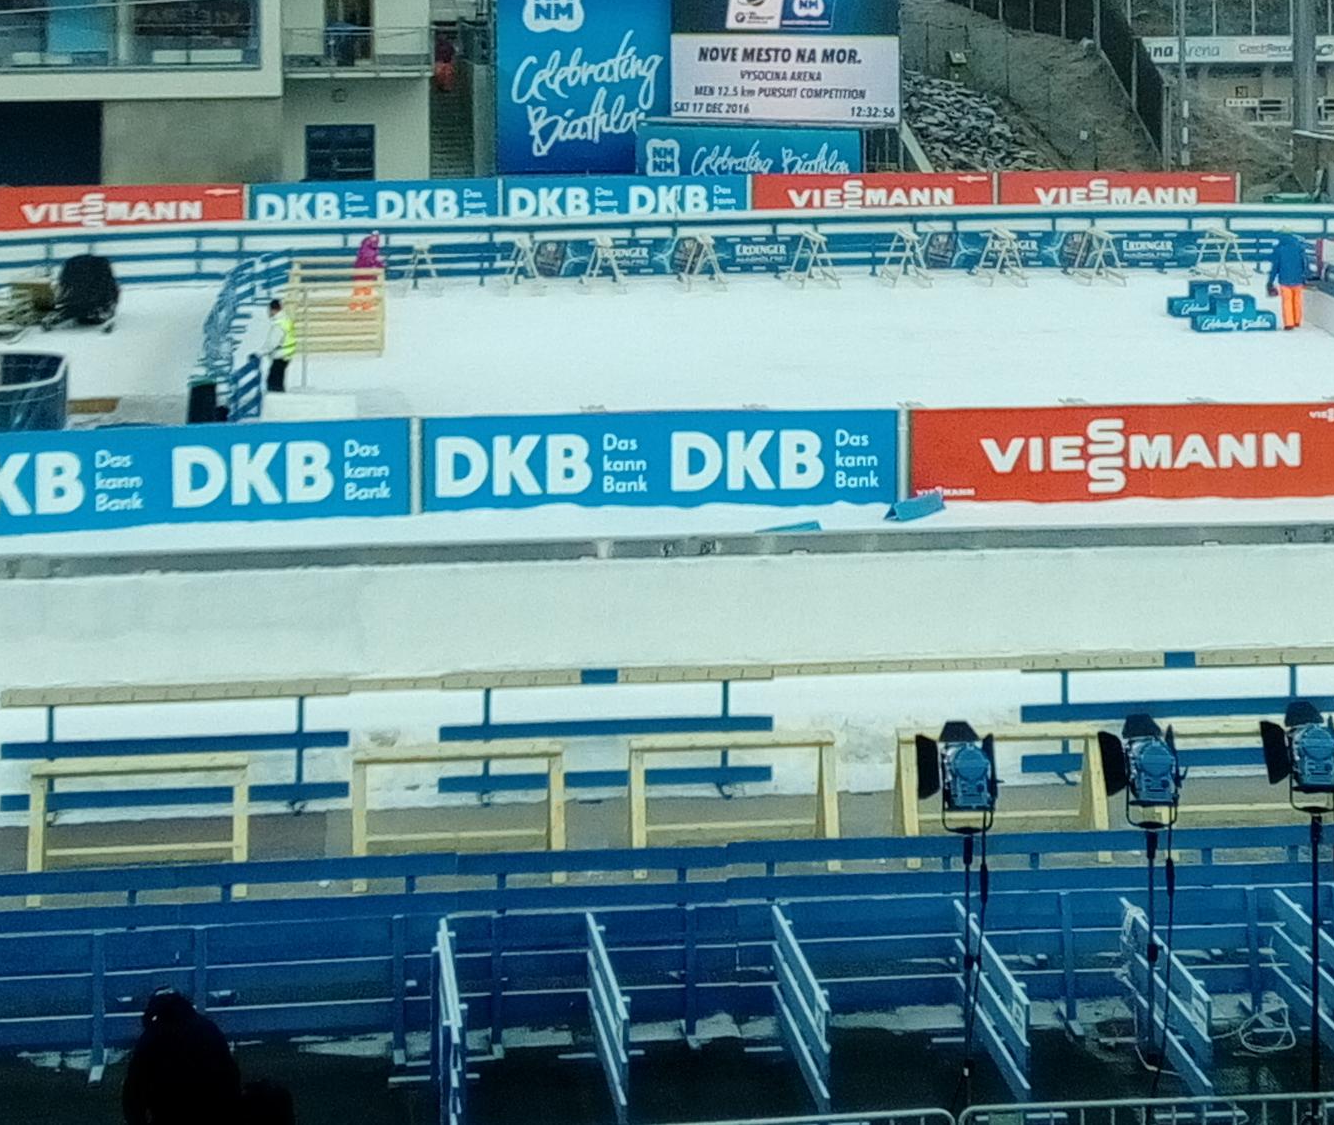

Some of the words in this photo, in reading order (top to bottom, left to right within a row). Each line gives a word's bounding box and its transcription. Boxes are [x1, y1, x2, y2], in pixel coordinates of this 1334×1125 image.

[534, 2, 574, 20] NM
[698, 46, 738, 62] NOVE
[741, 47, 792, 63] MESTO
[795, 48, 817, 63] NA
[821, 48, 862, 64] MOR.
[511, 29, 664, 111] Celebrating
[740, 70, 787, 81] VYSOCINA
[790, 71, 822, 82] ARENA
[694, 86, 715, 97] MEN
[717, 86, 738, 97] 12.5
[740, 86, 755, 97] km
[757, 87, 797, 98] PURSUIT
[800, 88, 866, 99] COMPETITION
[674, 102, 689, 113] SAT
[692, 102, 703, 113] 17
[705, 102, 723, 113] DEC
[725, 103, 750, 114] 2016
[850, 106, 896, 118] 12:32:56
[691, 139, 773, 175] Celebrating
[781, 142, 850, 175] Biathlon
[256, 191, 341, 220] DKB
[376, 188, 460, 219] DKB
[509, 186, 591, 217] DKB
[628, 184, 709, 214] DKB
[20, 192, 203, 228] VIESSMANN
[602, 433, 638, 452] Das
[835, 429, 870, 447] Das
[344, 439, 381, 459] Das
[835, 450, 879, 468] kann
[980, 418, 1303, 494] VIESSMANN
[95, 450, 133, 470] Das
[344, 461, 391, 479] kann
[434, 433, 594, 499] DKB
[602, 454, 648, 473] kann
[670, 428, 825, 493] DKB
[95, 473, 144, 491] kann
[171, 439, 335, 509] DKB
[835, 471, 880, 489] Bank
[344, 482, 393, 502] Bank
[602, 475, 649, 494] Bank
[95, 493, 145, 513] Bank
